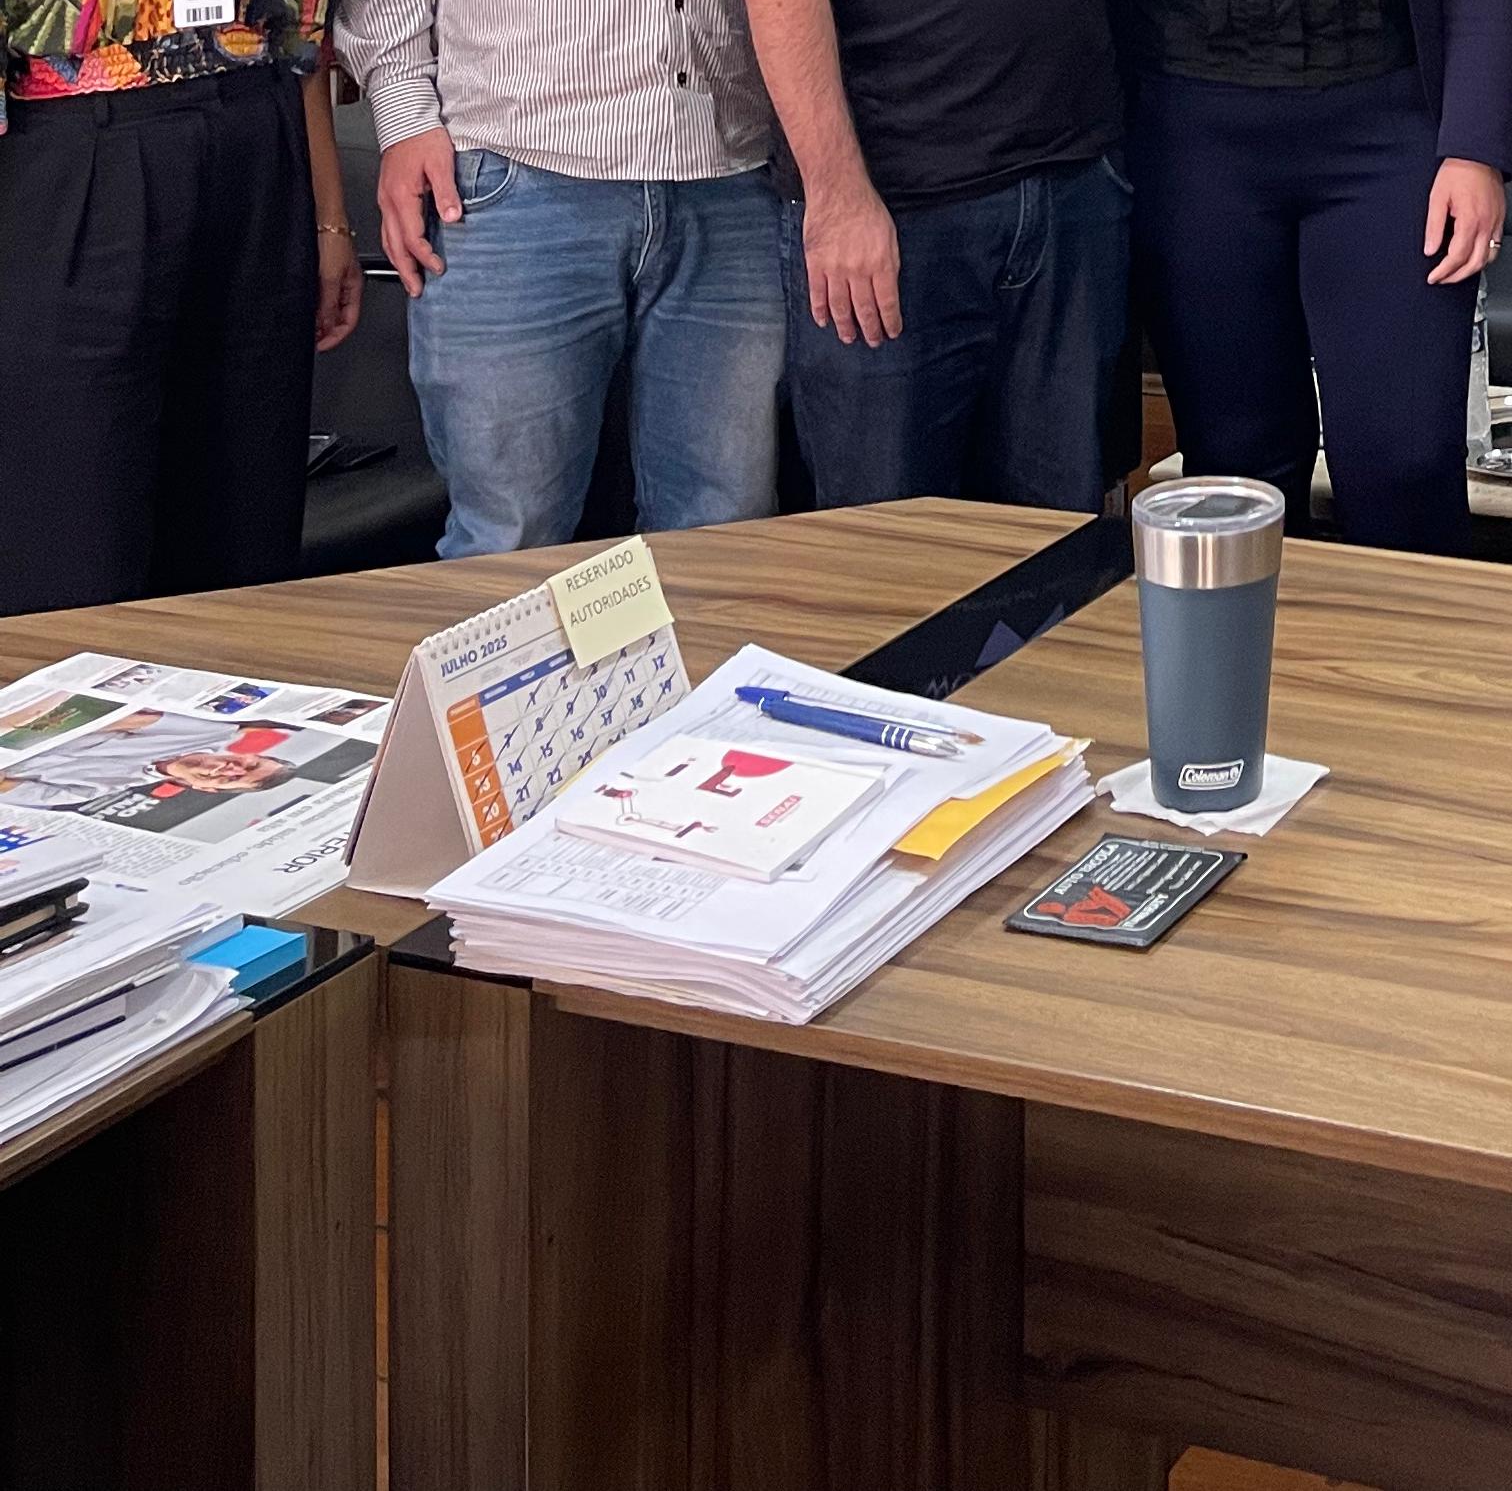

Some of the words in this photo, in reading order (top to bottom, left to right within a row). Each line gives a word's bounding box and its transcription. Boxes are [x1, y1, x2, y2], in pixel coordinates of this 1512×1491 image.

[566, 550, 633, 592] RESERVADO
[570, 575, 651, 627] AUTORIDADES
[441, 650, 477, 677] JULHO
[480, 635, 507, 658] 2025
[593, 685, 607, 701] 10
[1185, 767, 1230, 783] Coleman
